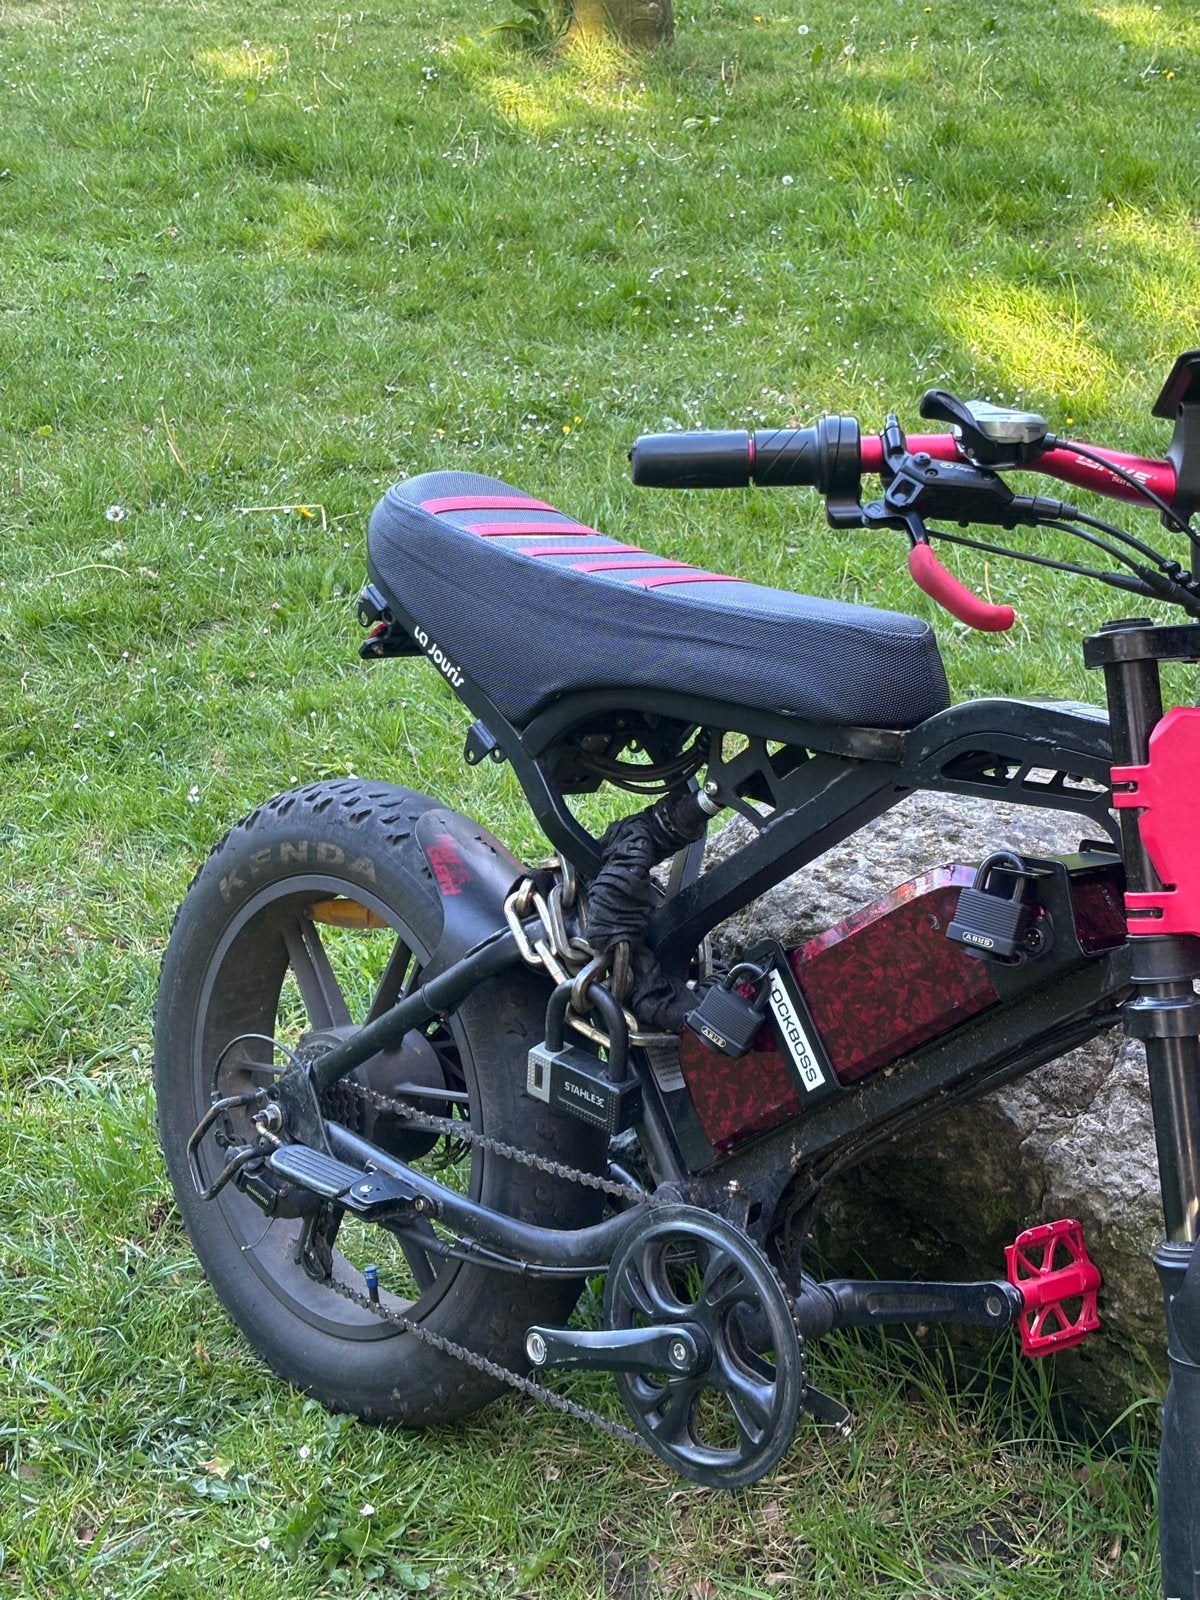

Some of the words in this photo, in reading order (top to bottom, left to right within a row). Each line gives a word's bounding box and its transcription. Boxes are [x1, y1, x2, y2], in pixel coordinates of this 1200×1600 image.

[218, 840, 378, 903] KENDA
[965, 933, 992, 947] ABUS
[769, 976, 817, 1083] OCKBOSS
